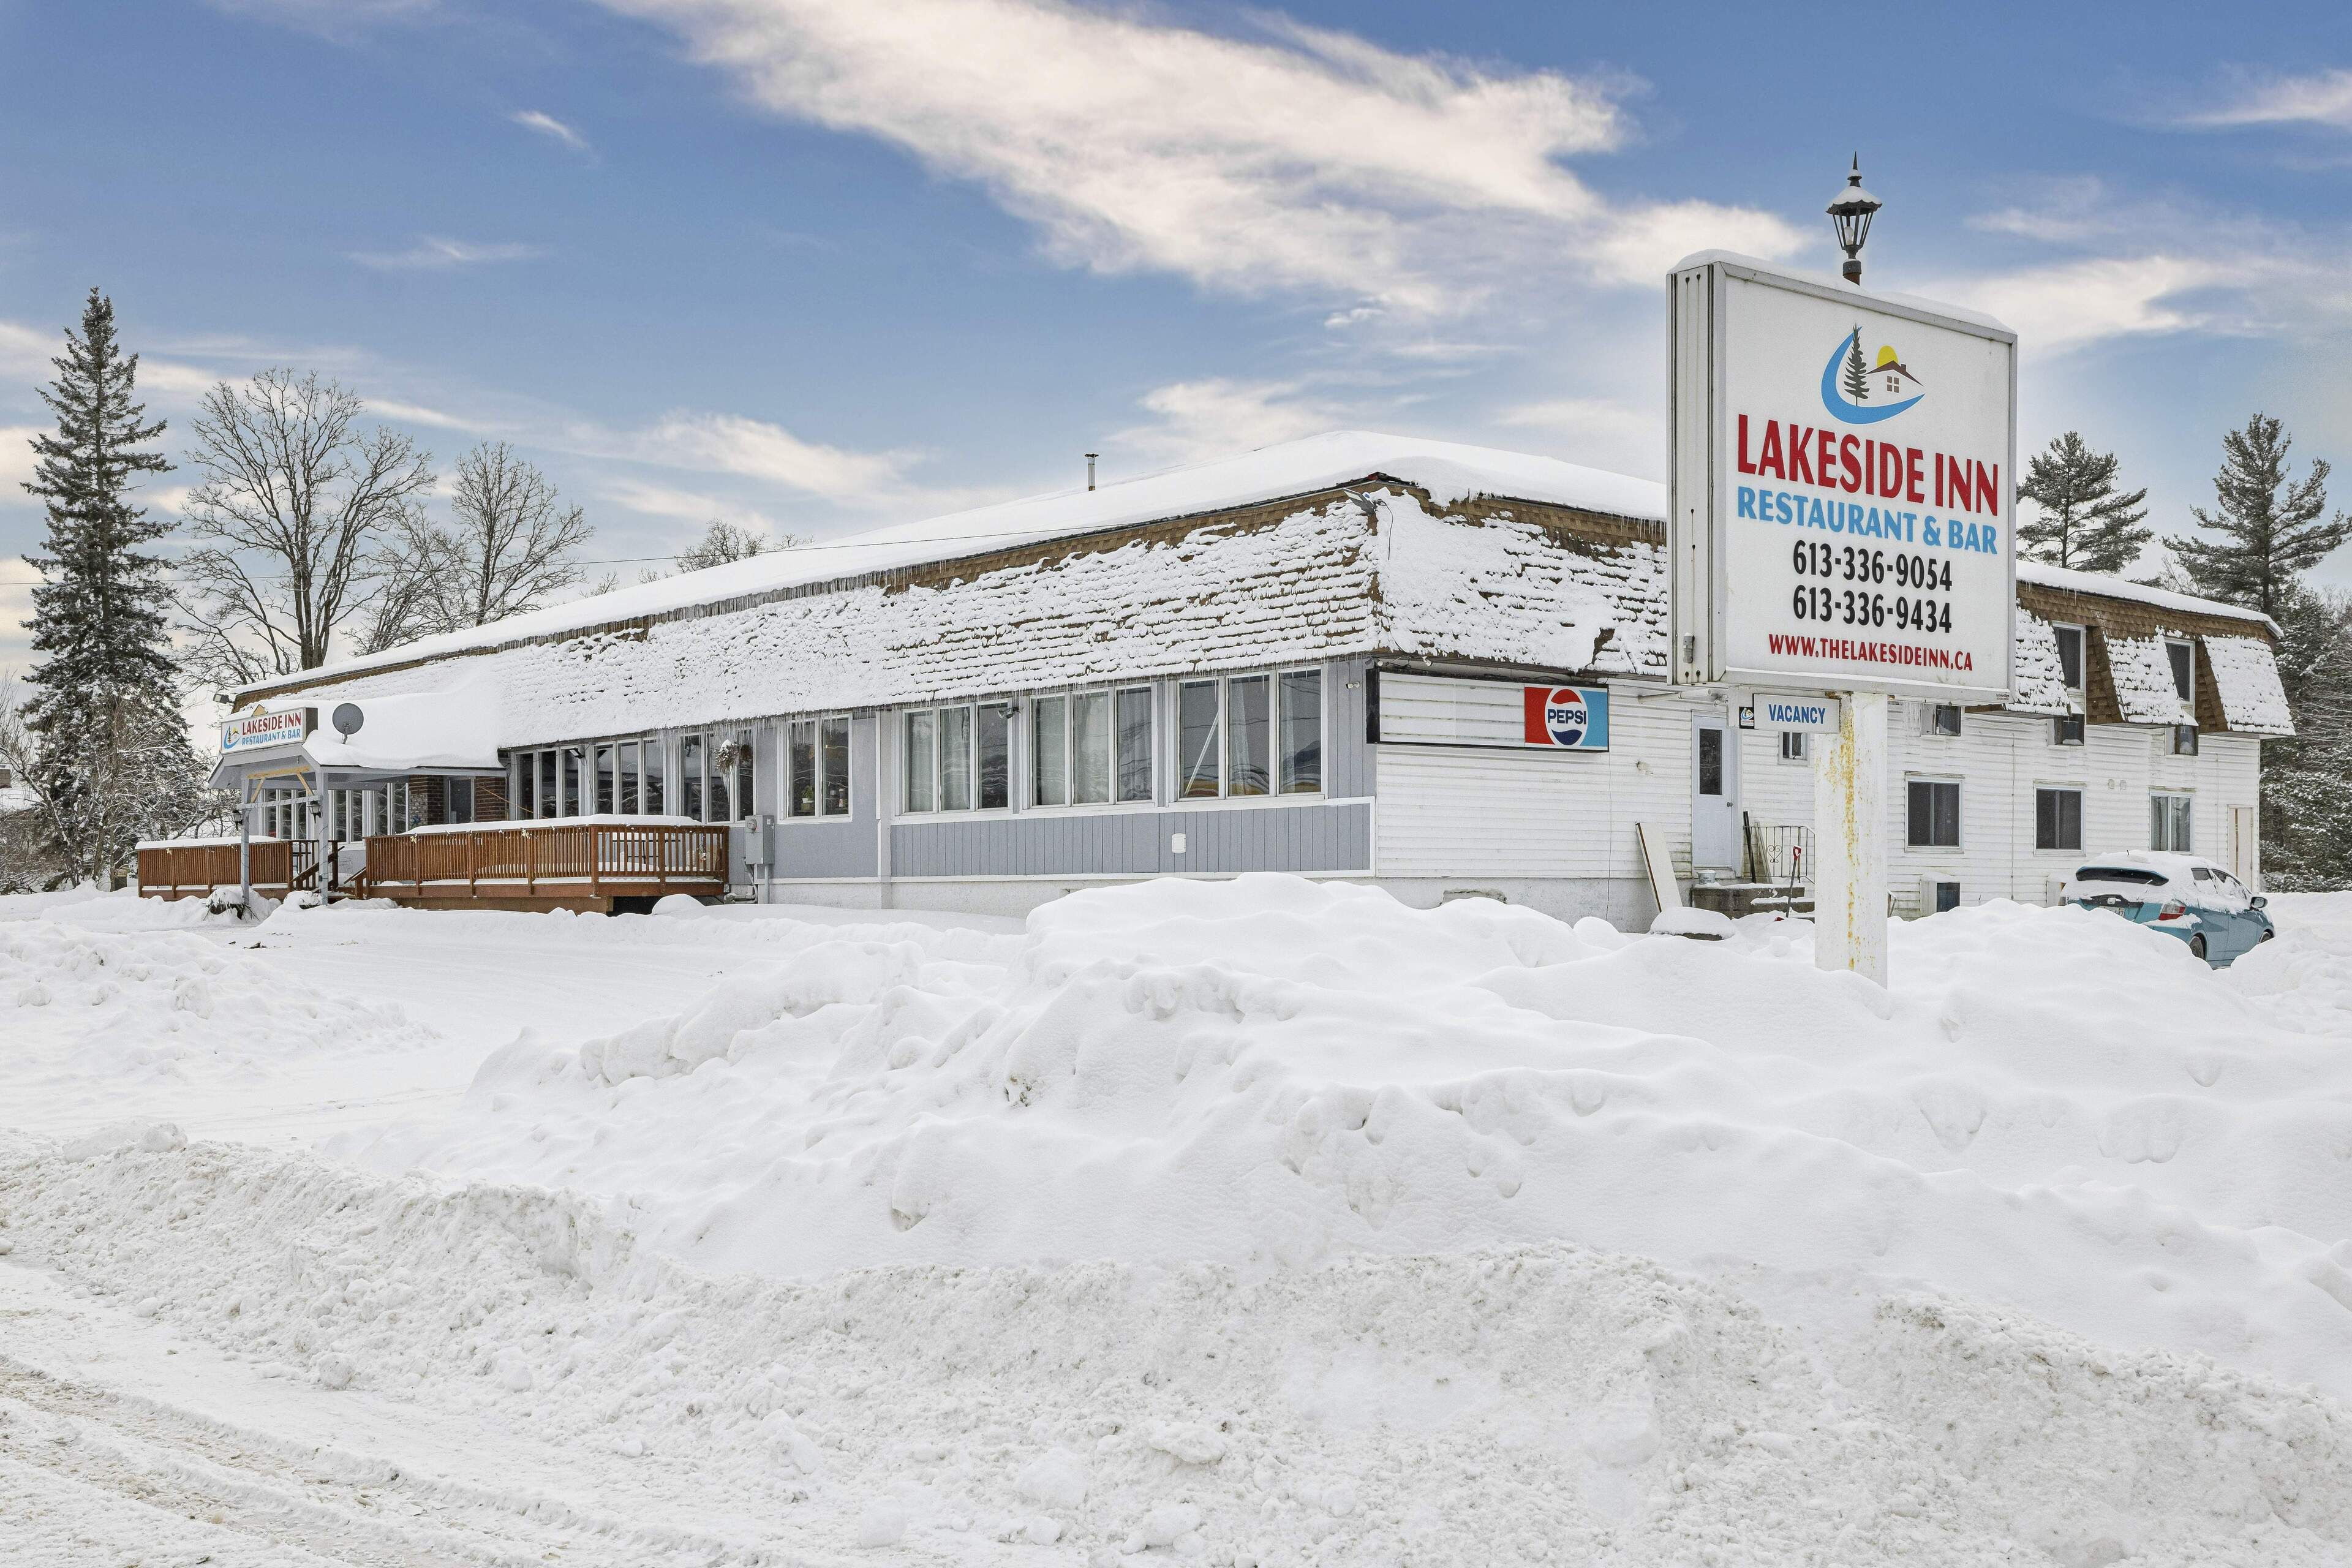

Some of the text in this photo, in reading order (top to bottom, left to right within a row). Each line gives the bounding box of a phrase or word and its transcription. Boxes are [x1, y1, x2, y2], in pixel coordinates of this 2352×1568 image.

[1737, 414, 1998, 516] LAKESIDE INN
[1737, 486, 1998, 555] RESTAURANT & BAR
[1793, 540, 1953, 592] 613-336-9054
[1793, 584, 1953, 633] 613-336-9434
[1768, 634, 1973, 671] WWW.THELAKESIDEINN.CA
[242, 712, 301, 736] LAKESIDE INN
[1547, 709, 1587, 725] PEPSI
[1768, 704, 1826, 724] VACANCY
[241, 728, 301, 745] RESTAURANT & BAR
